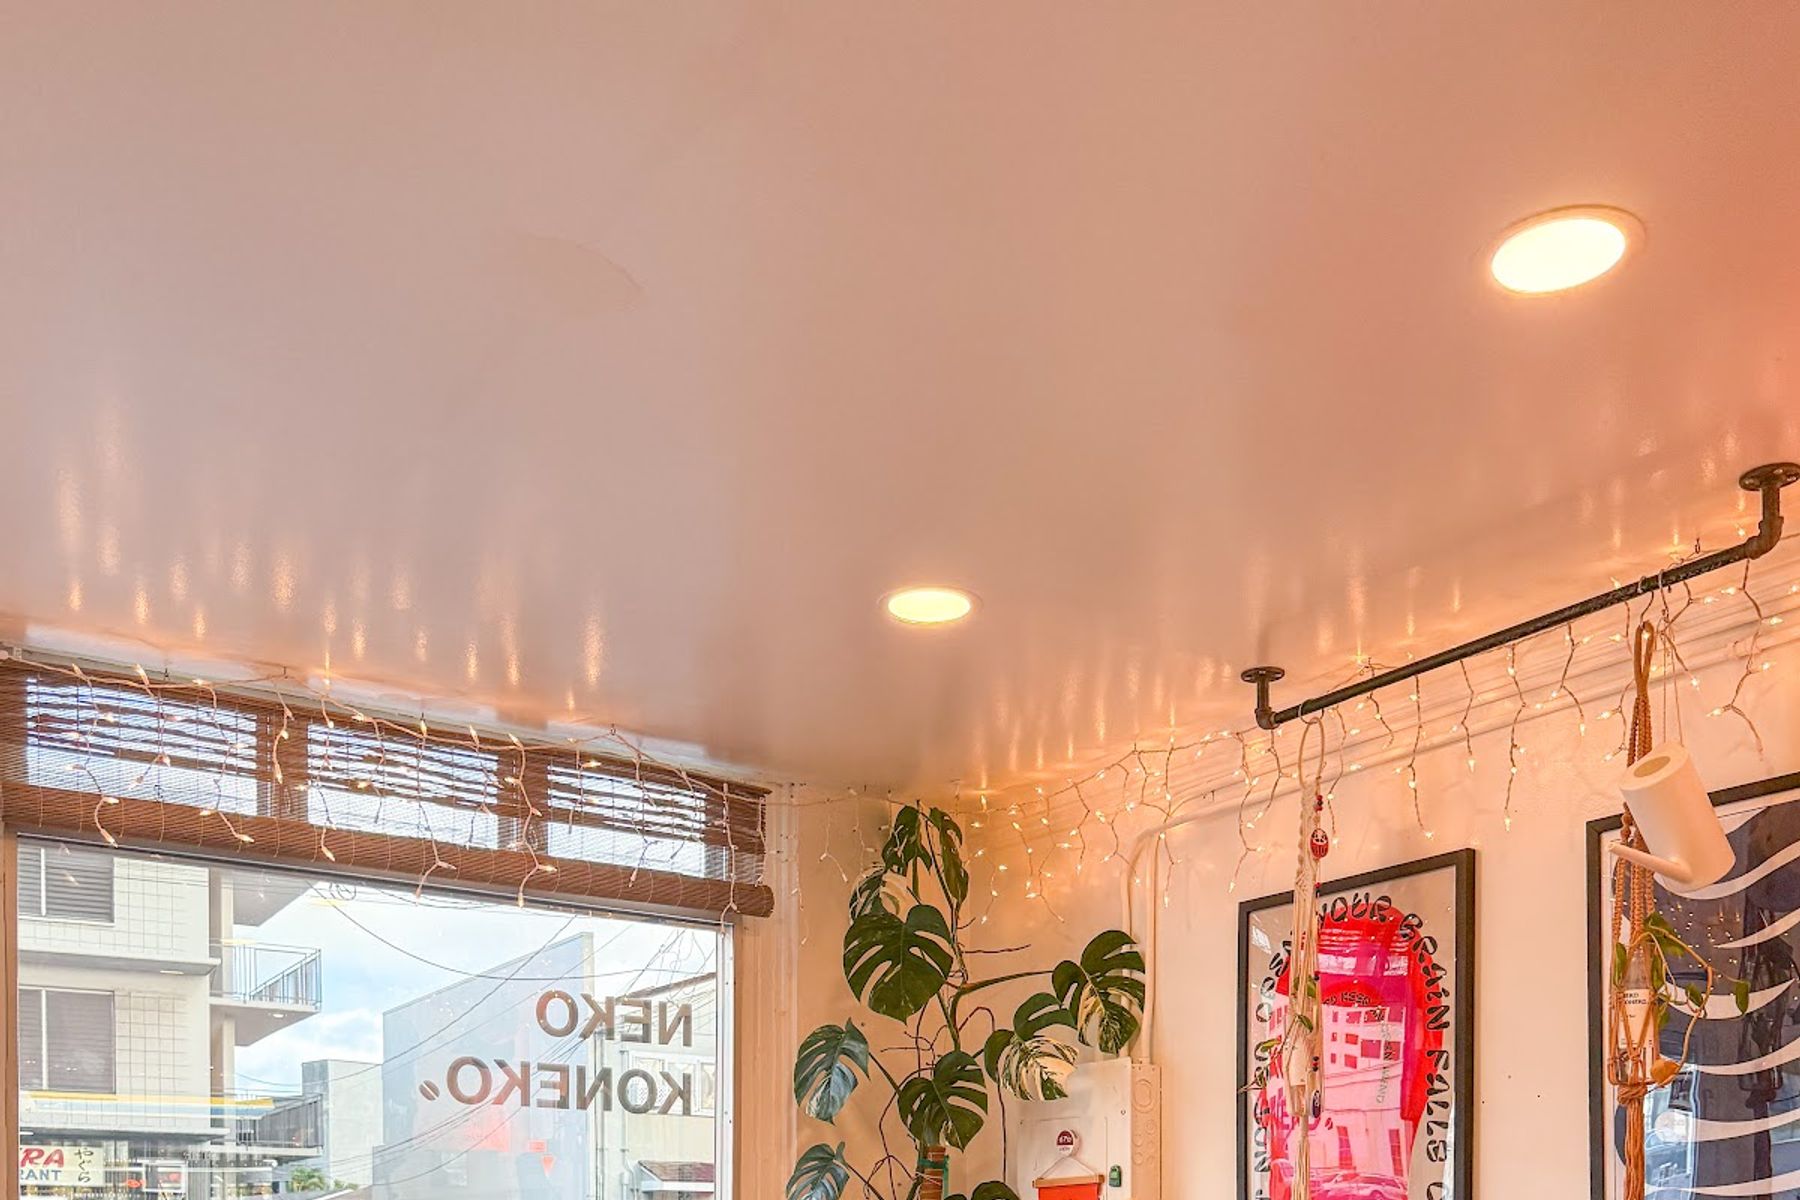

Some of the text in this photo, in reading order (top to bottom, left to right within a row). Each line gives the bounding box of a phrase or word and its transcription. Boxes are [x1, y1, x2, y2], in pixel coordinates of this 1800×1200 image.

[1399, 913, 1451, 1031] BRAIN
[1426, 1050, 1450, 1163] FALLS
[20, 1147, 65, 1168] RA
[74, 1147, 94, 1183] やぐら
